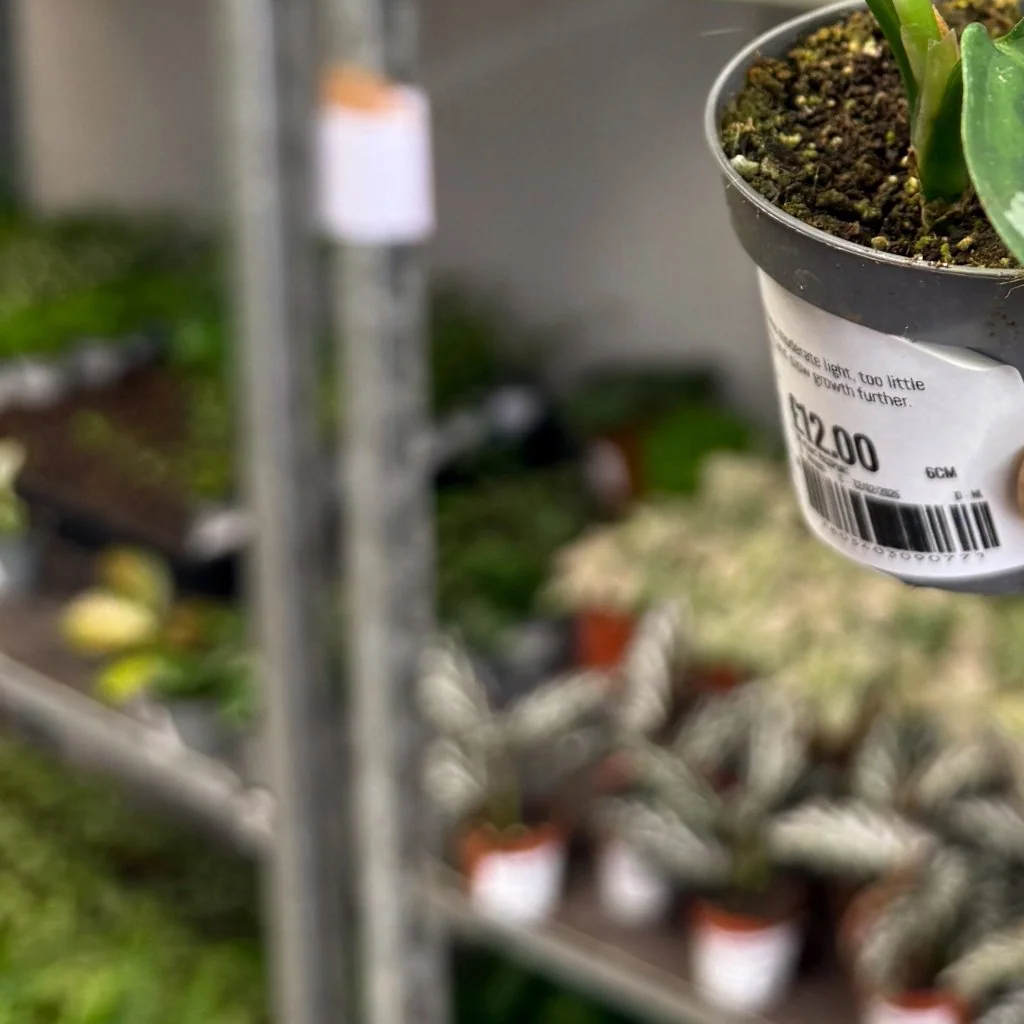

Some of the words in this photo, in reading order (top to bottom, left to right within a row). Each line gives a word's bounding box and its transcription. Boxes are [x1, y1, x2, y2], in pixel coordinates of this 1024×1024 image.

[779, 329, 821, 367] erate
[858, 371, 883, 387] too
[886, 375, 926, 391] little
[813, 372, 855, 398] growth
[857, 387, 912, 407] further.
[925, 465, 957, 479] 6CM
